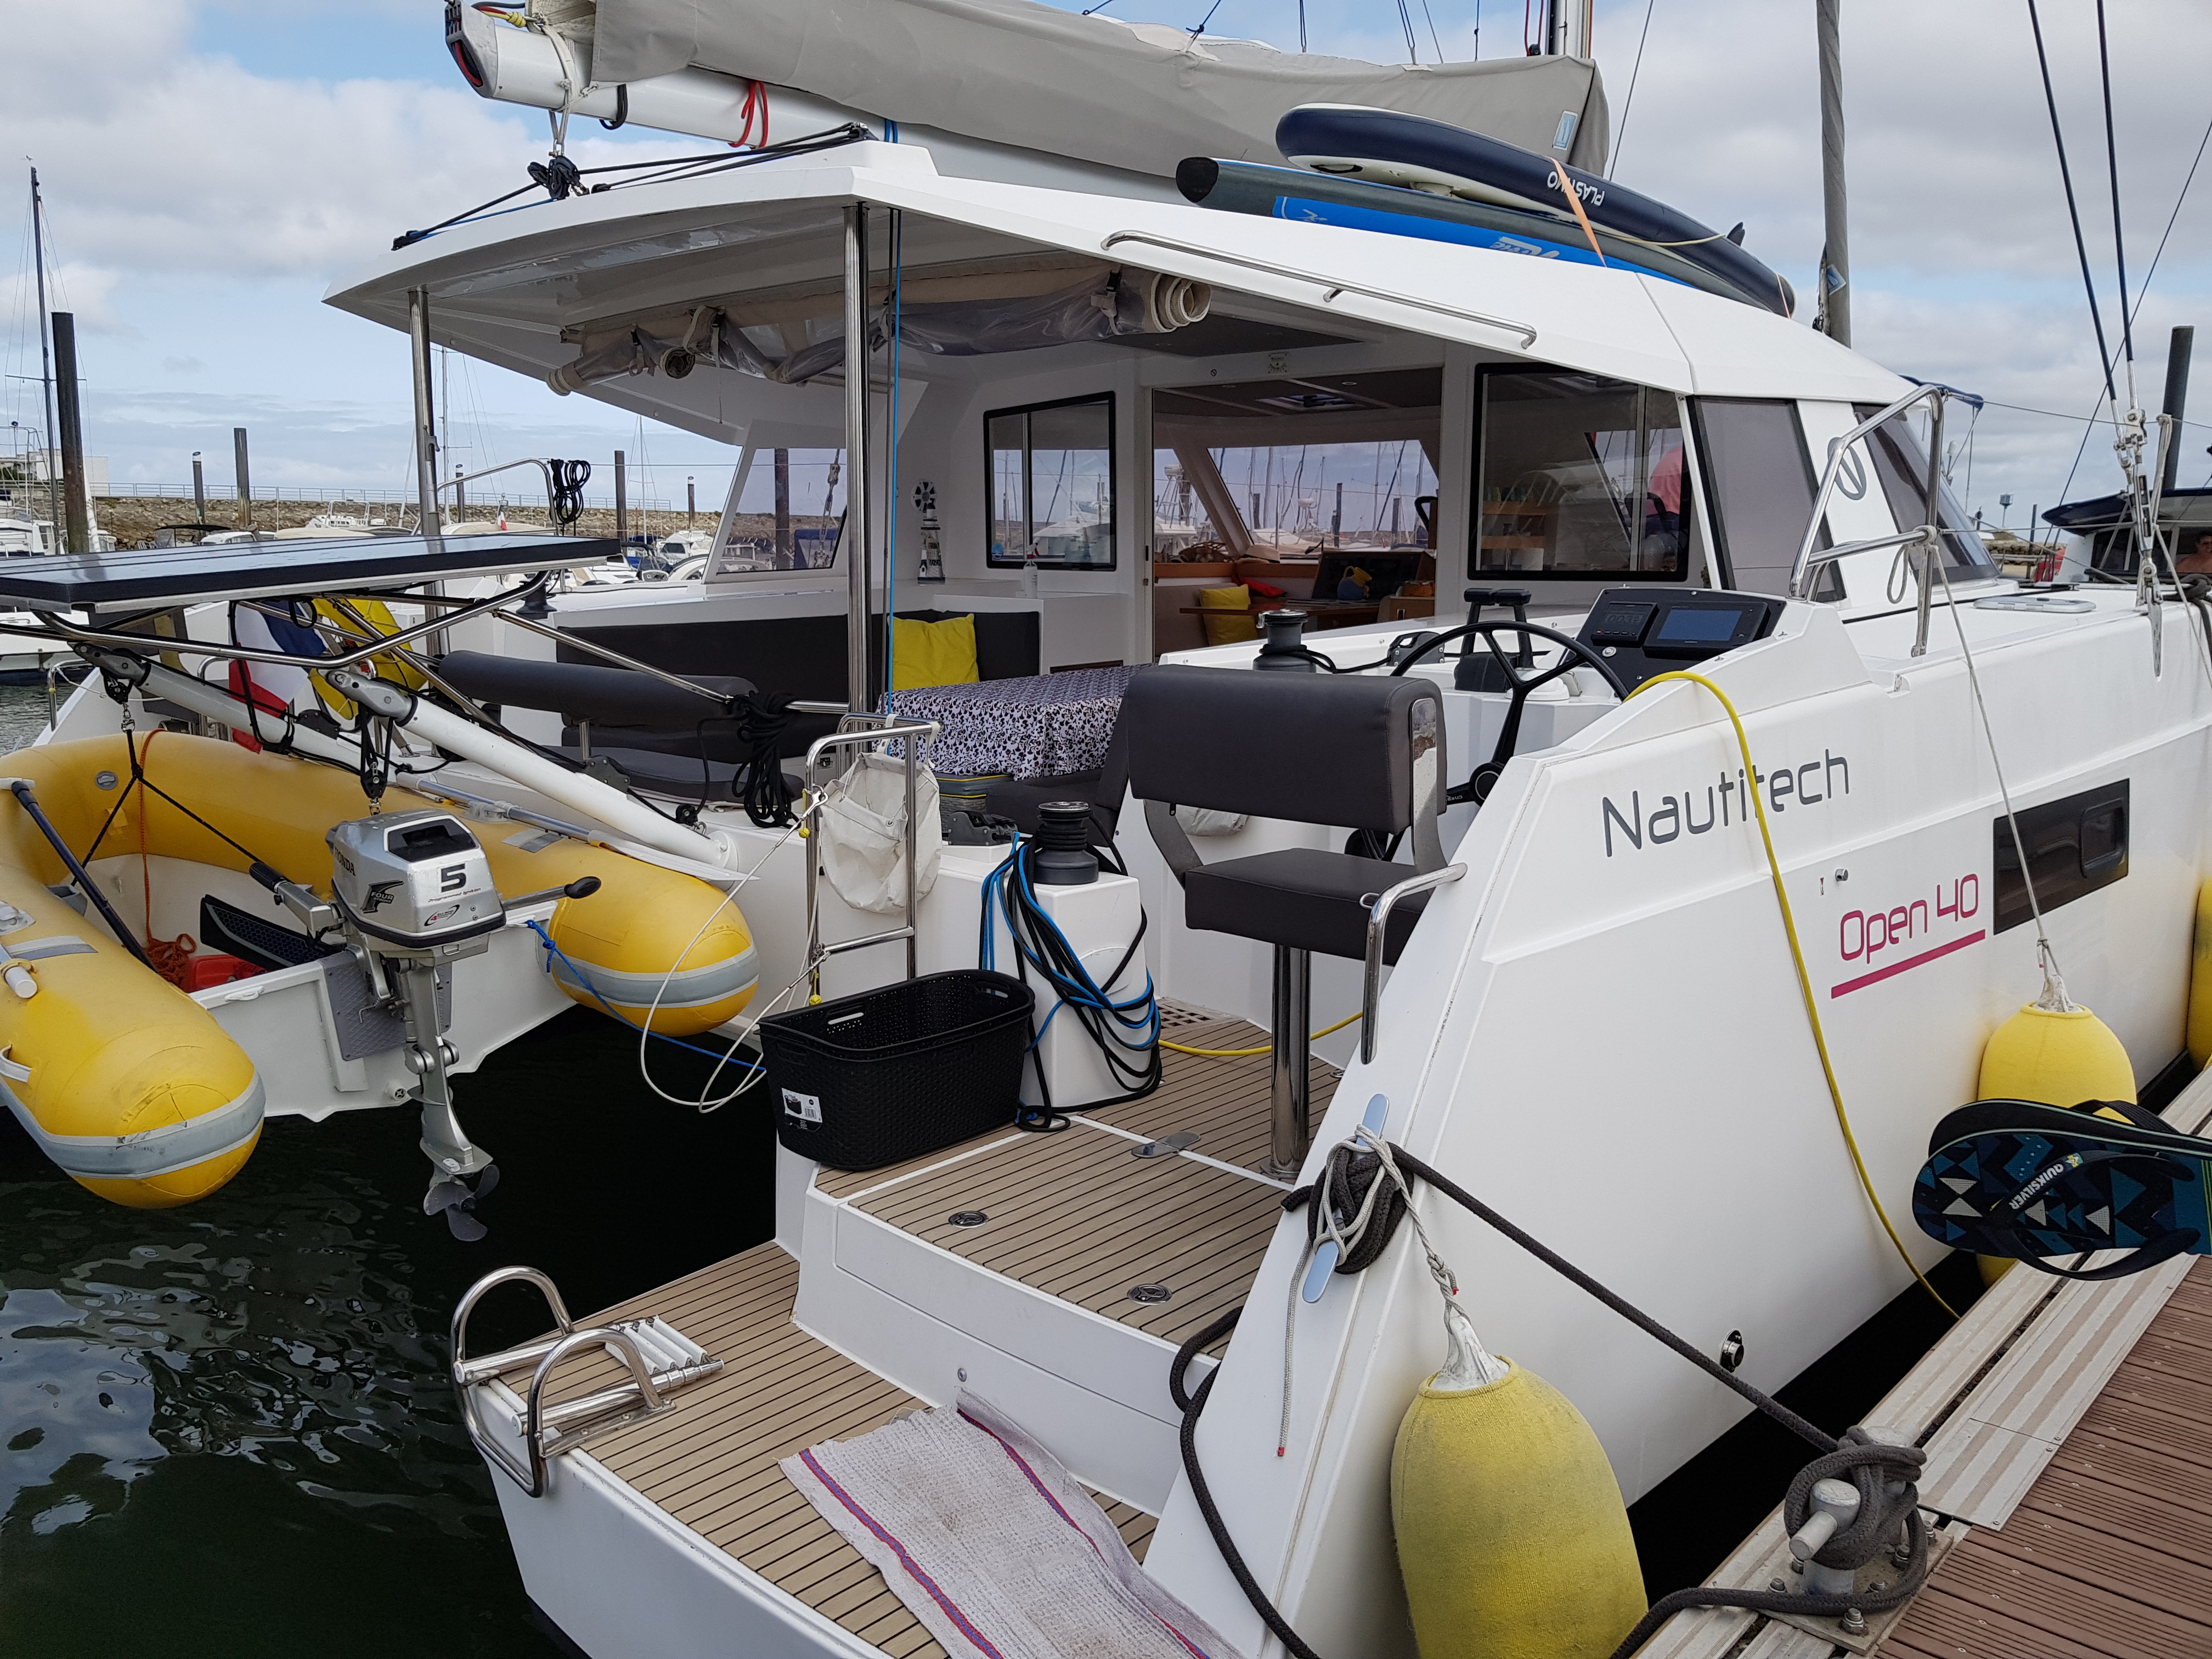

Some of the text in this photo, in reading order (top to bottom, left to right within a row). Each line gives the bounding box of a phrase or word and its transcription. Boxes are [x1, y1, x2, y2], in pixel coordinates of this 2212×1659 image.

[1602, 748, 1849, 857] Nautitech
[335, 847, 356, 877] HONDA
[441, 862, 466, 894] 5
[371, 891, 394, 900] FOUR
[1840, 873, 1978, 964] Open 40
[2008, 1164, 2064, 1210] QUIKSILVER
